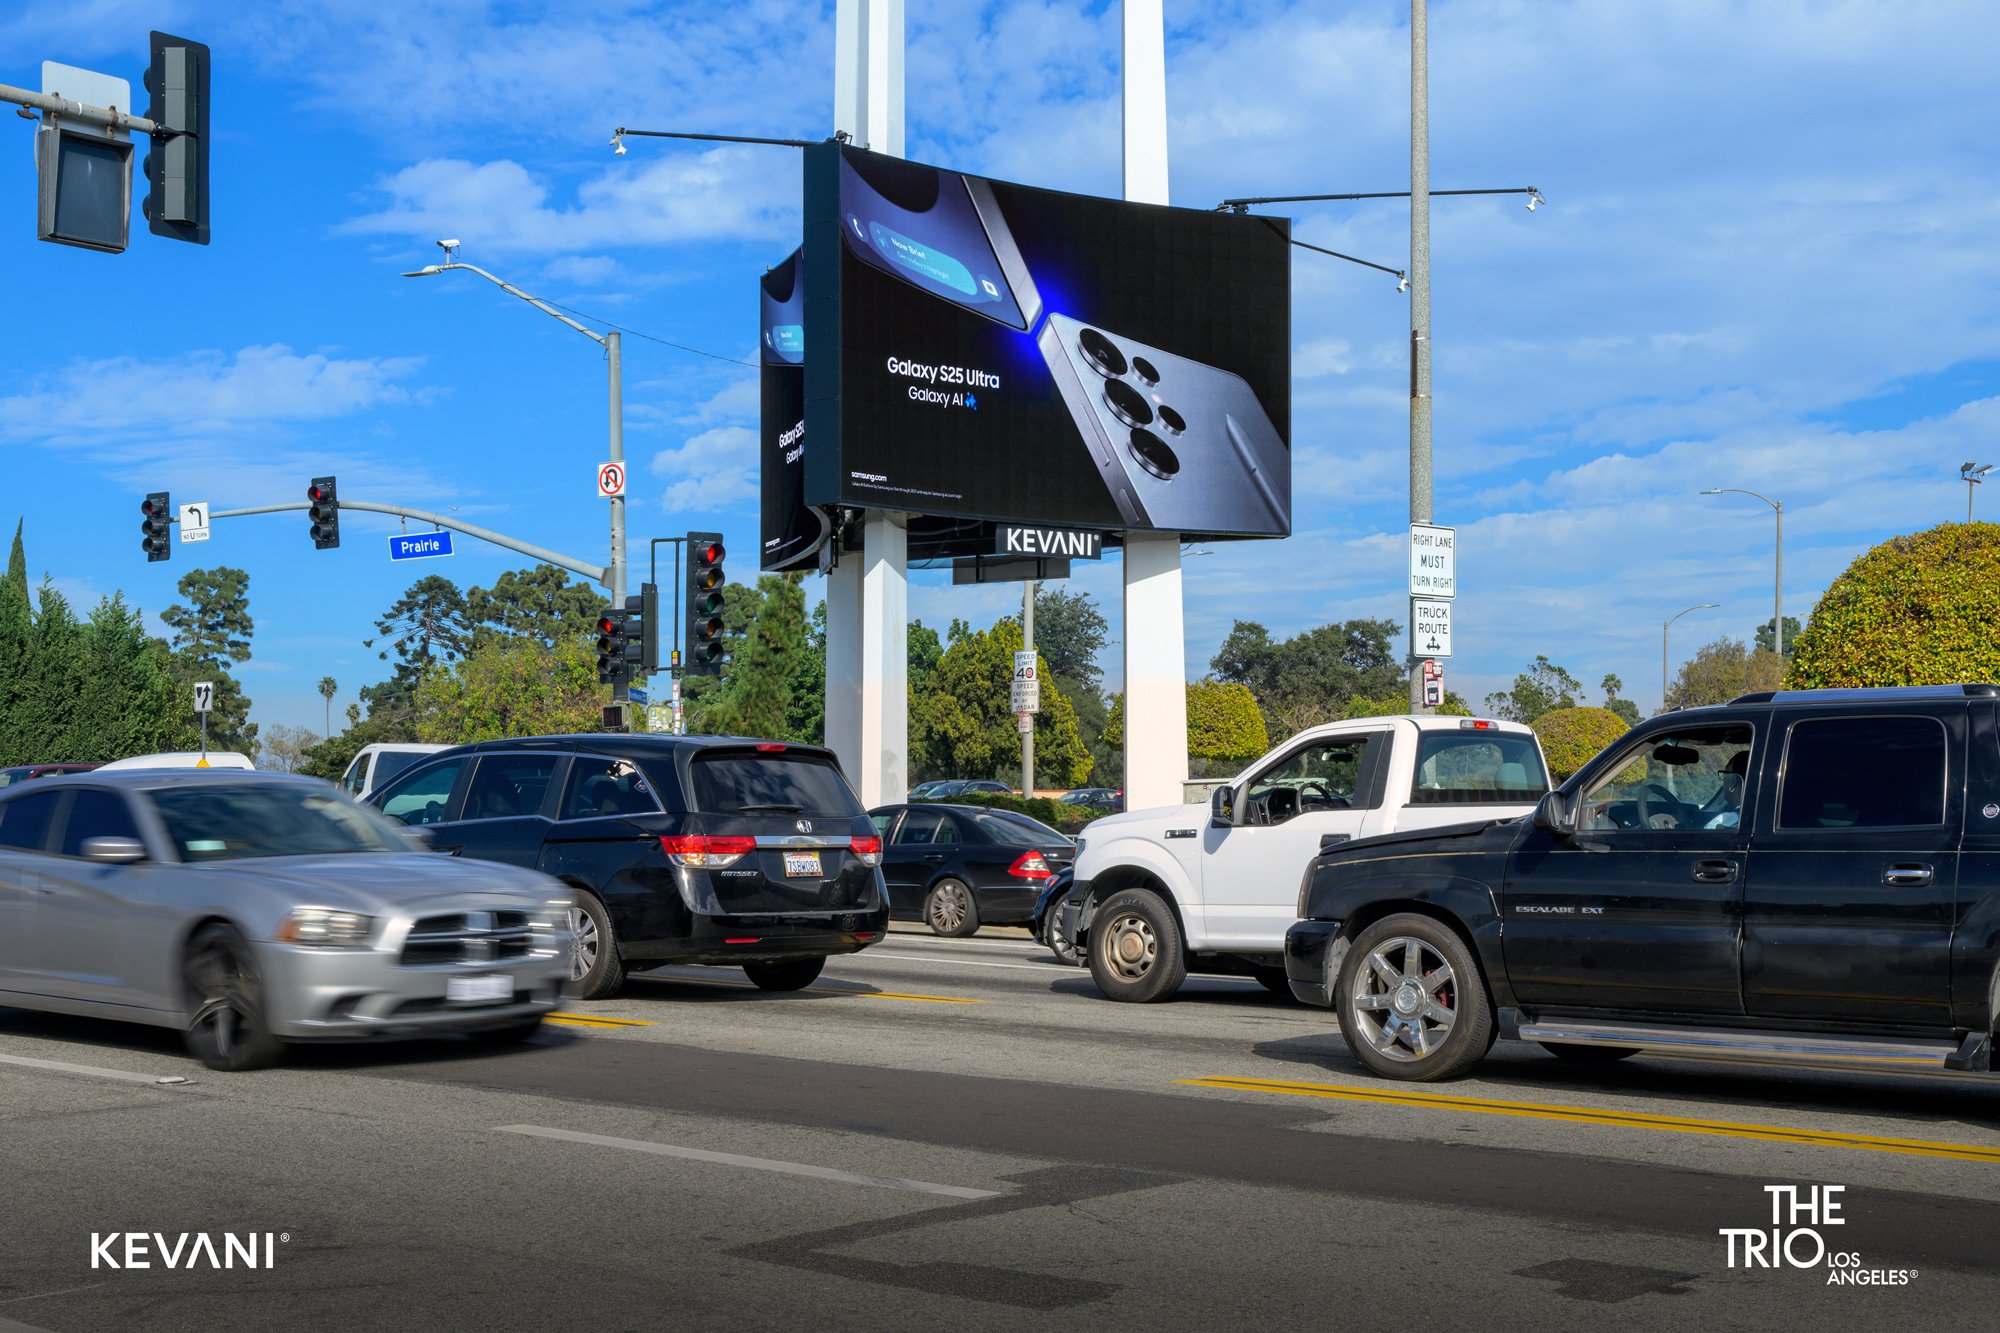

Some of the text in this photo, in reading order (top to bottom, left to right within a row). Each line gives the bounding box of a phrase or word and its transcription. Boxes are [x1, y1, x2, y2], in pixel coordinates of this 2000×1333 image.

[887, 356, 1000, 389] Galaxy S25 Ultra
[908, 386, 963, 408] Galaxy AI
[851, 471, 887, 483] samsung.com
[401, 539, 440, 554] Prairie
[1413, 534, 1452, 548] RIGHT LANE
[1421, 554, 1444, 569] MUST
[1413, 575, 1452, 588] TURN RIGHT
[1418, 607, 1448, 619] TRUCK
[1418, 623, 1448, 634] ROUTE
[1016, 667, 1034, 679] 40
